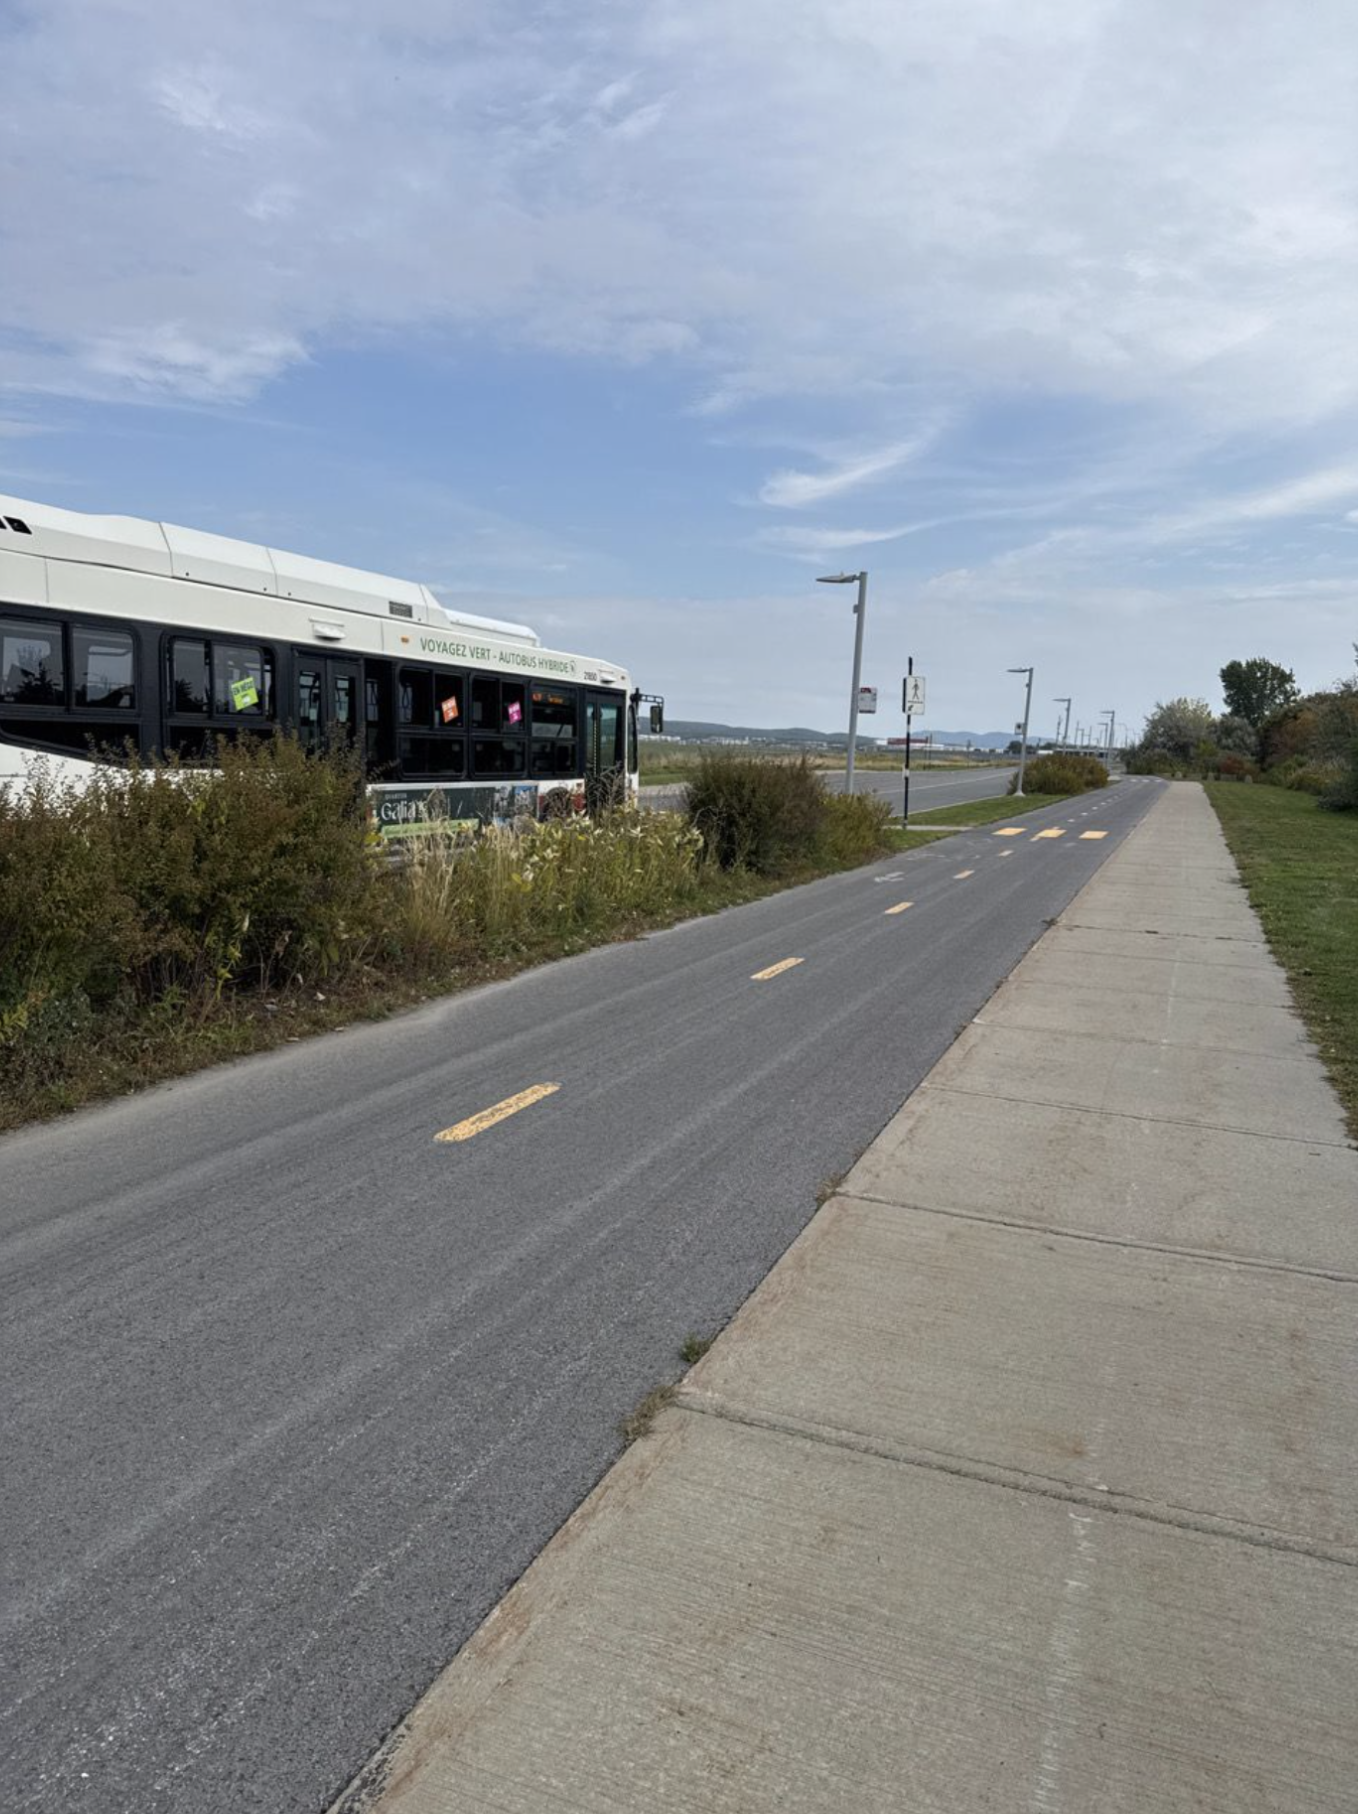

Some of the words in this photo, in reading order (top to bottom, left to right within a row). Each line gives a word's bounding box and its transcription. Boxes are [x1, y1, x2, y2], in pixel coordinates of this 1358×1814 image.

[420, 637, 467, 657] VOYAGEZ
[469, 646, 491, 660] VERT
[499, 651, 537, 668] AUTOBUS
[538, 658, 569, 673] HYBRIDE
